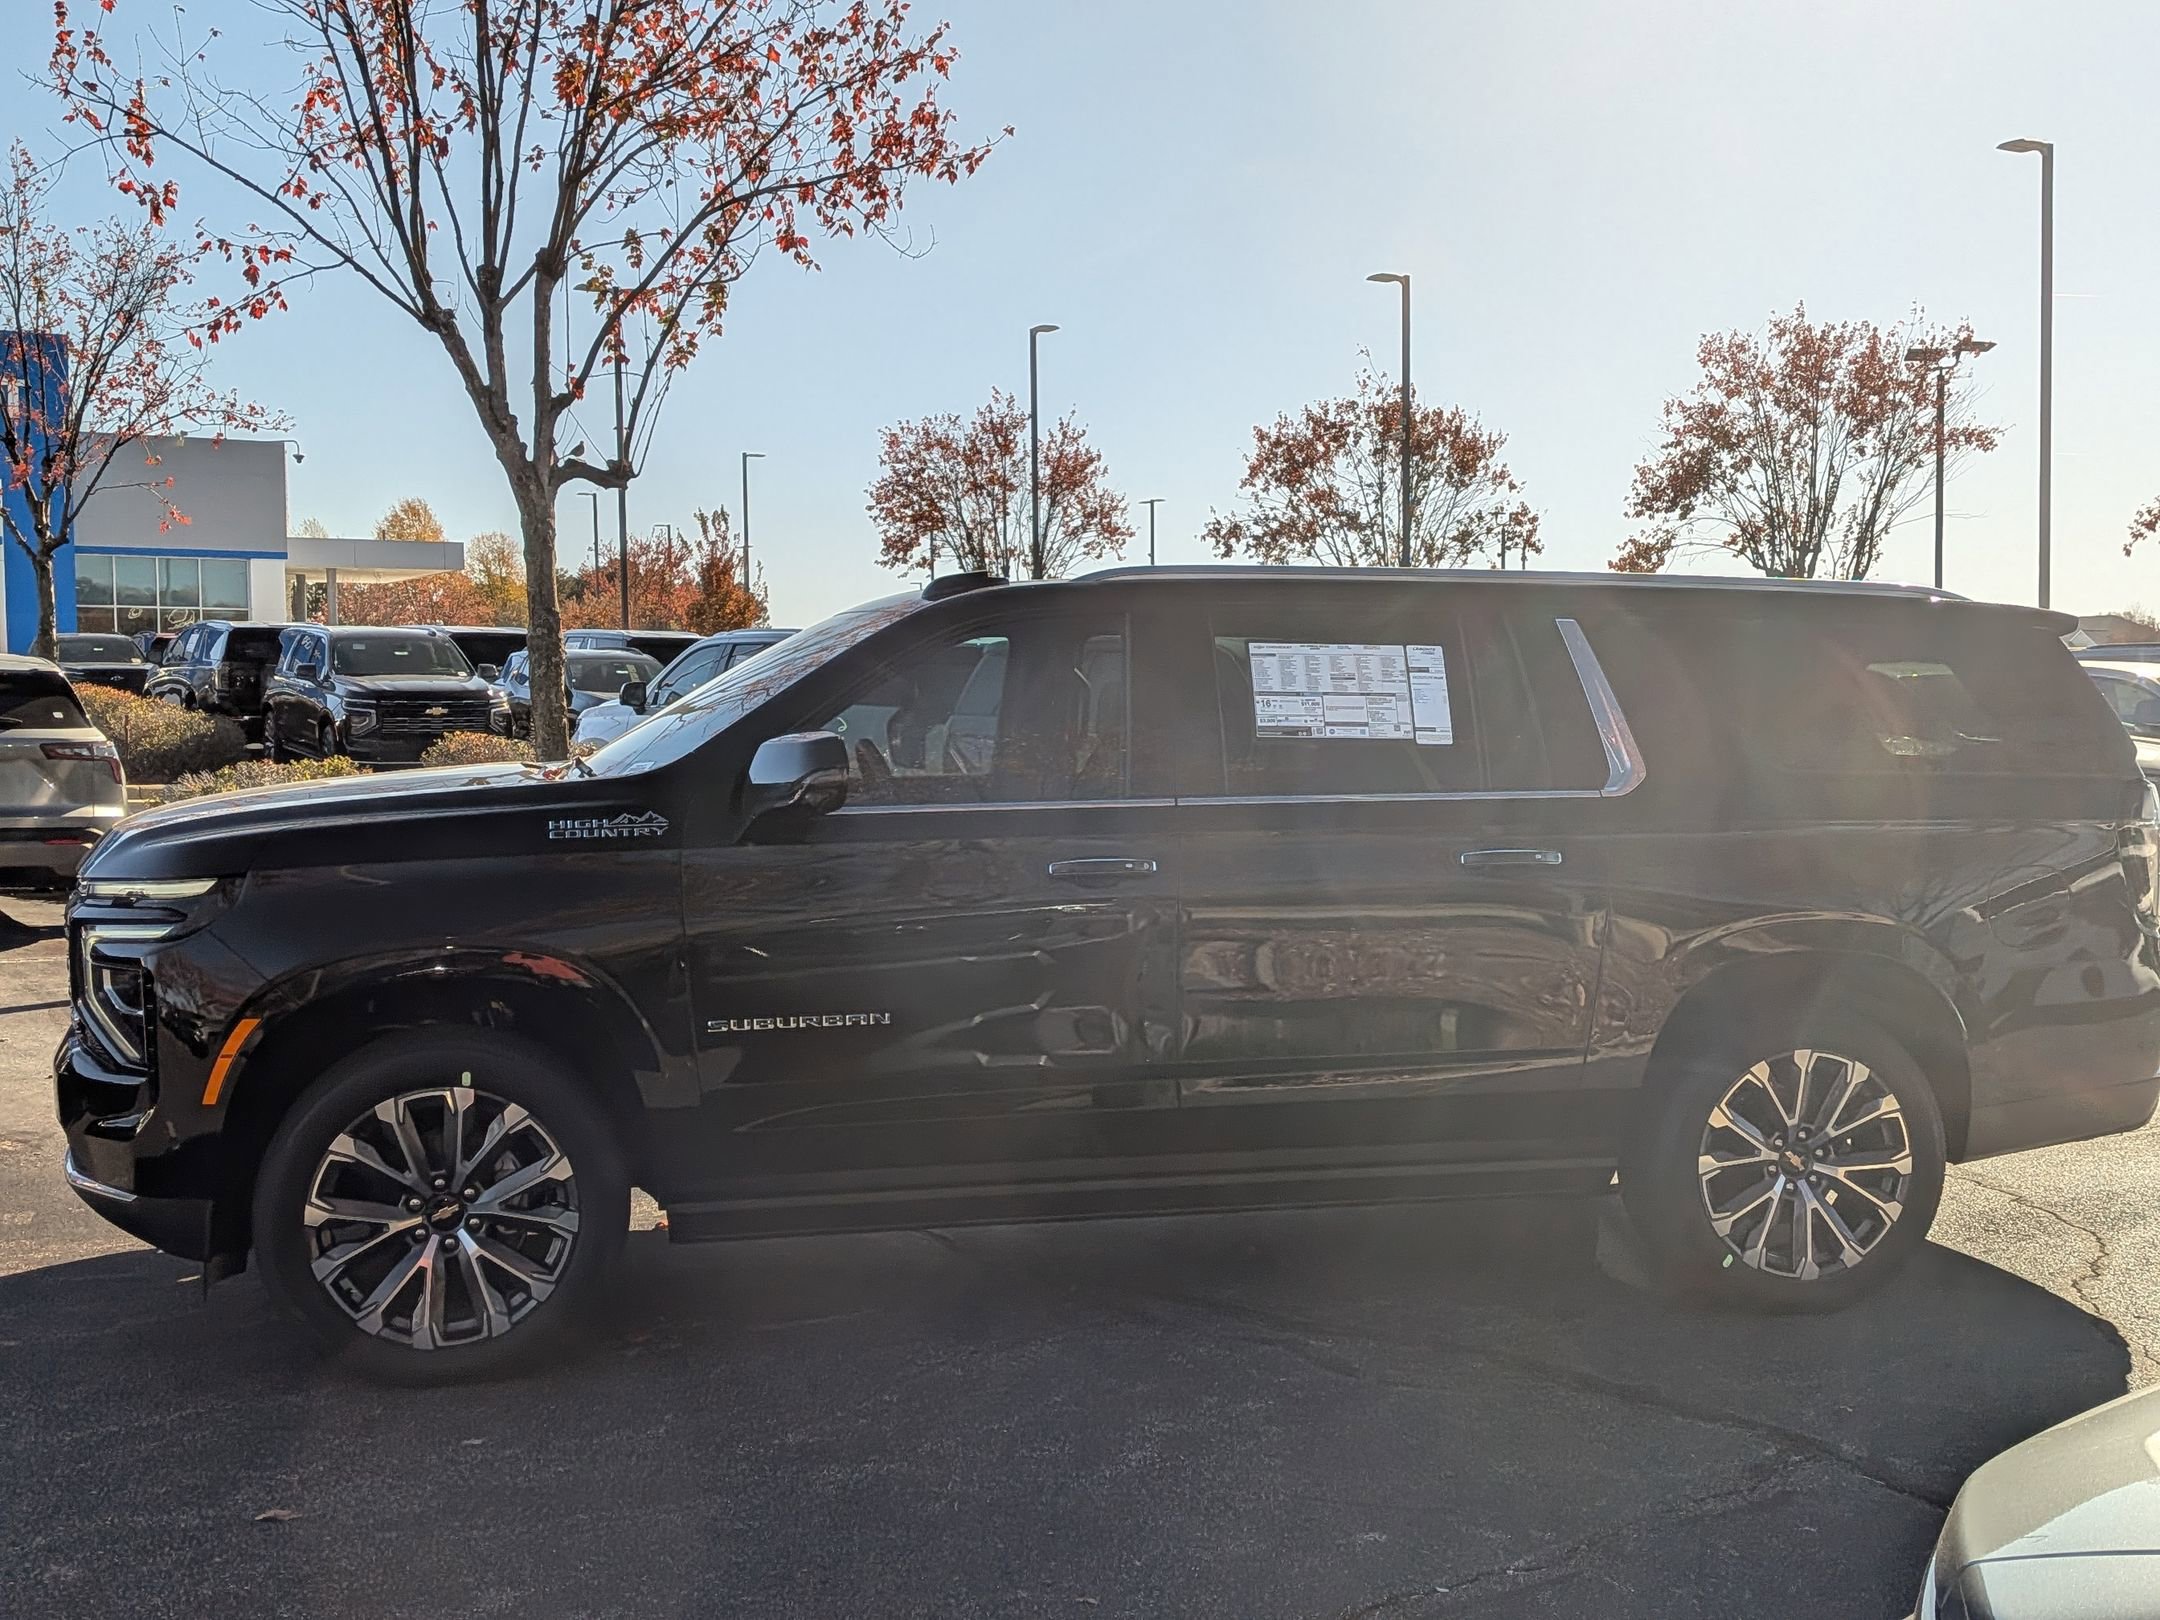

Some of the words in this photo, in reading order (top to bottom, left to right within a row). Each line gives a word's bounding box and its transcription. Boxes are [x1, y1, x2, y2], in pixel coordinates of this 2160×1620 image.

[548, 819, 609, 830] HIGH
[548, 826, 669, 839] COUNTRY
[707, 1012, 891, 1033] SUBURBAN
